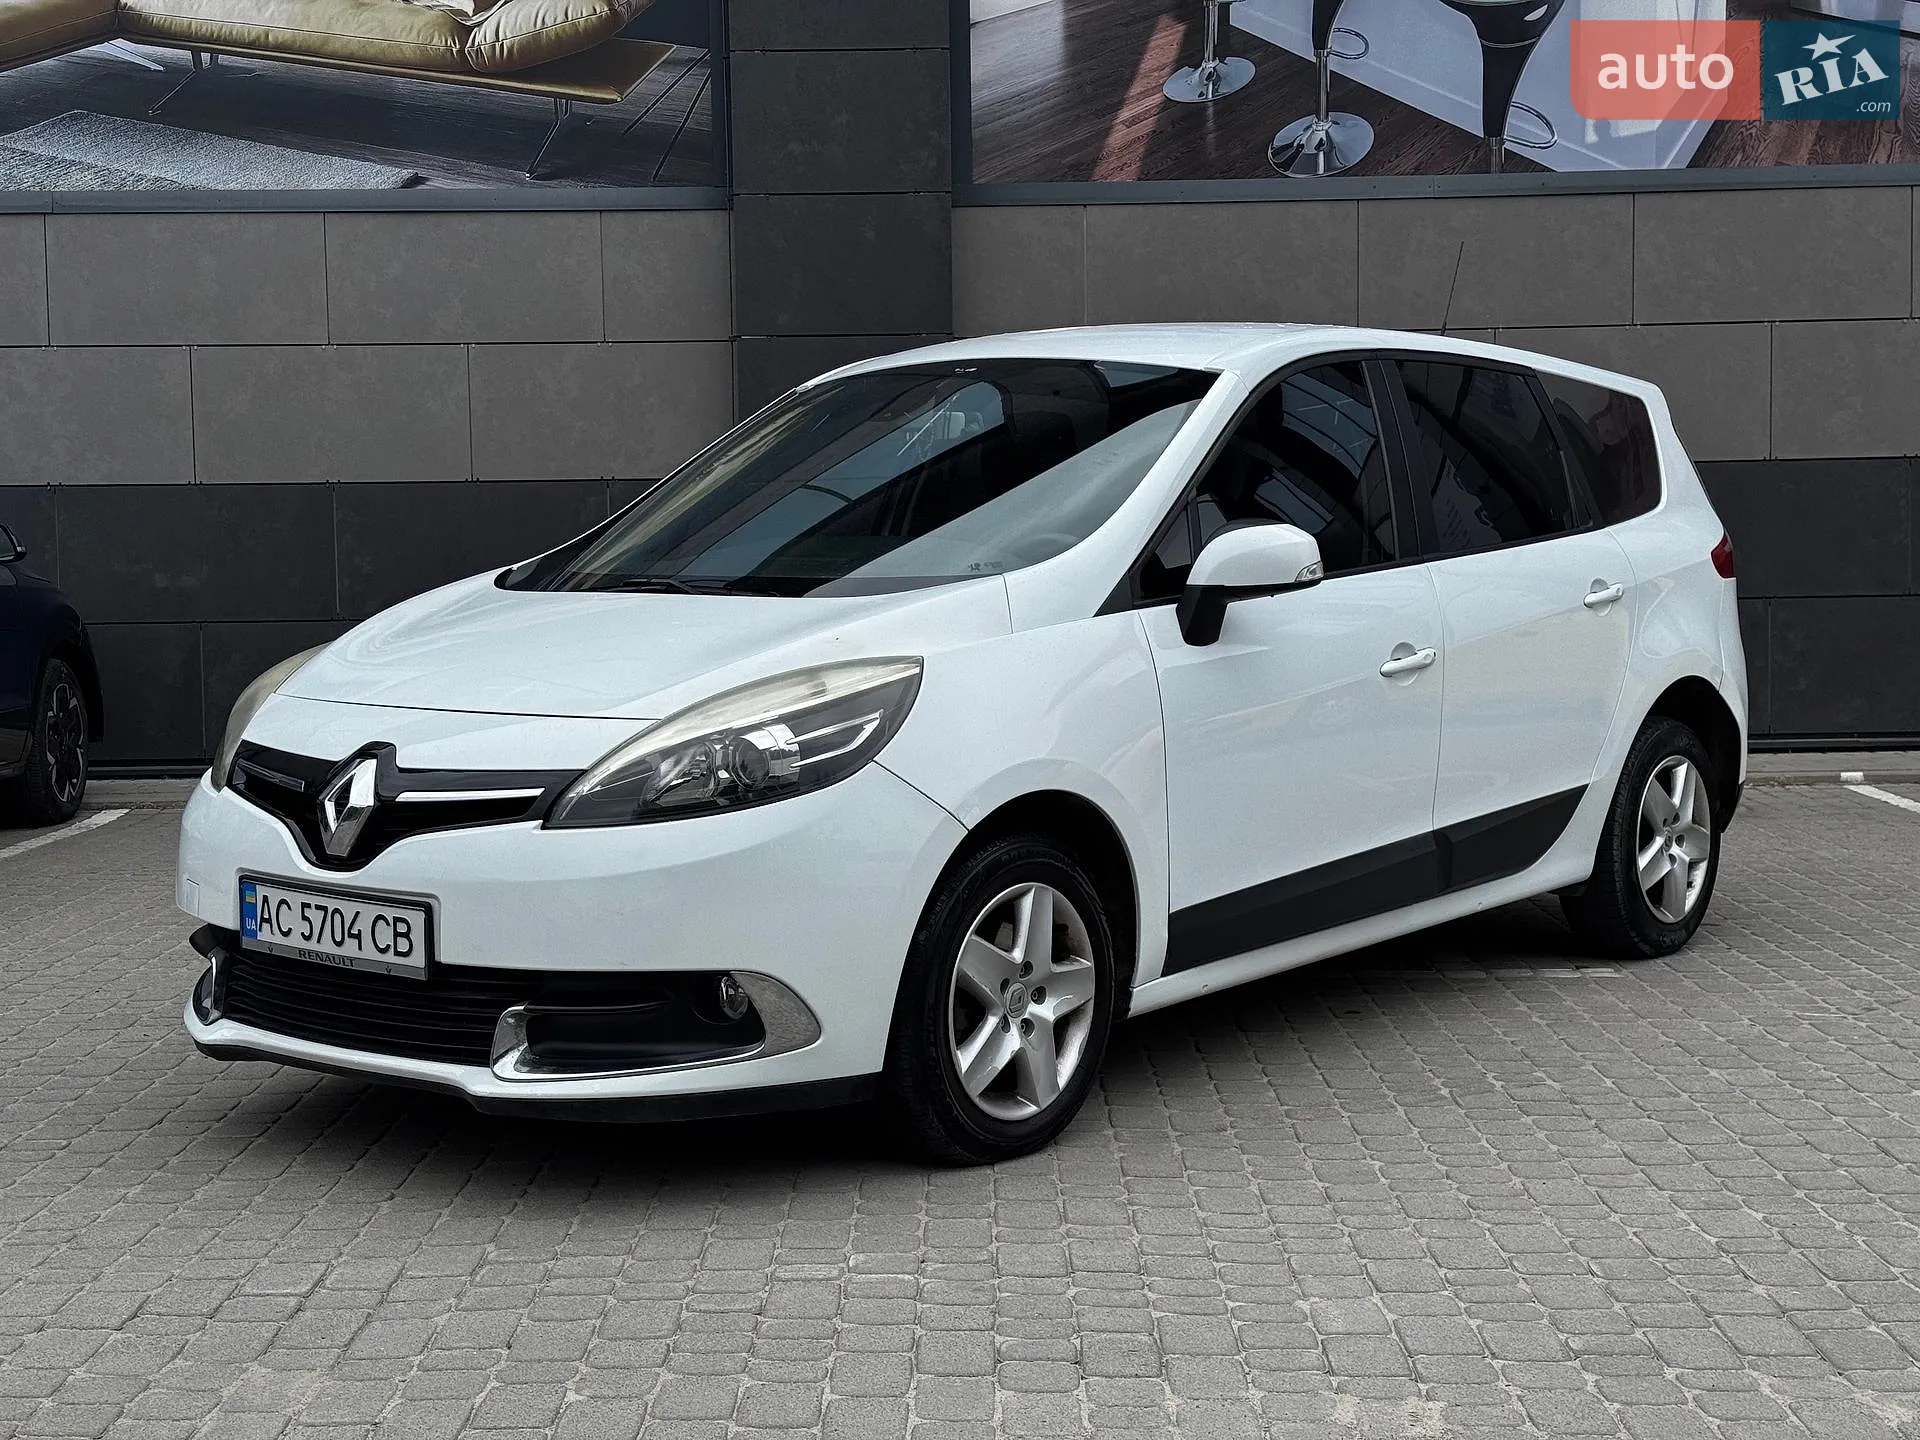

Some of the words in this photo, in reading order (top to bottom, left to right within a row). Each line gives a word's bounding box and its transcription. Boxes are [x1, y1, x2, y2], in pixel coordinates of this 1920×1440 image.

[245, 917, 256, 930] UA
[258, 894, 293, 937] AC
[300, 902, 363, 952] 5704
[371, 913, 414, 957] CB
[298, 950, 355, 968] RENAULT
